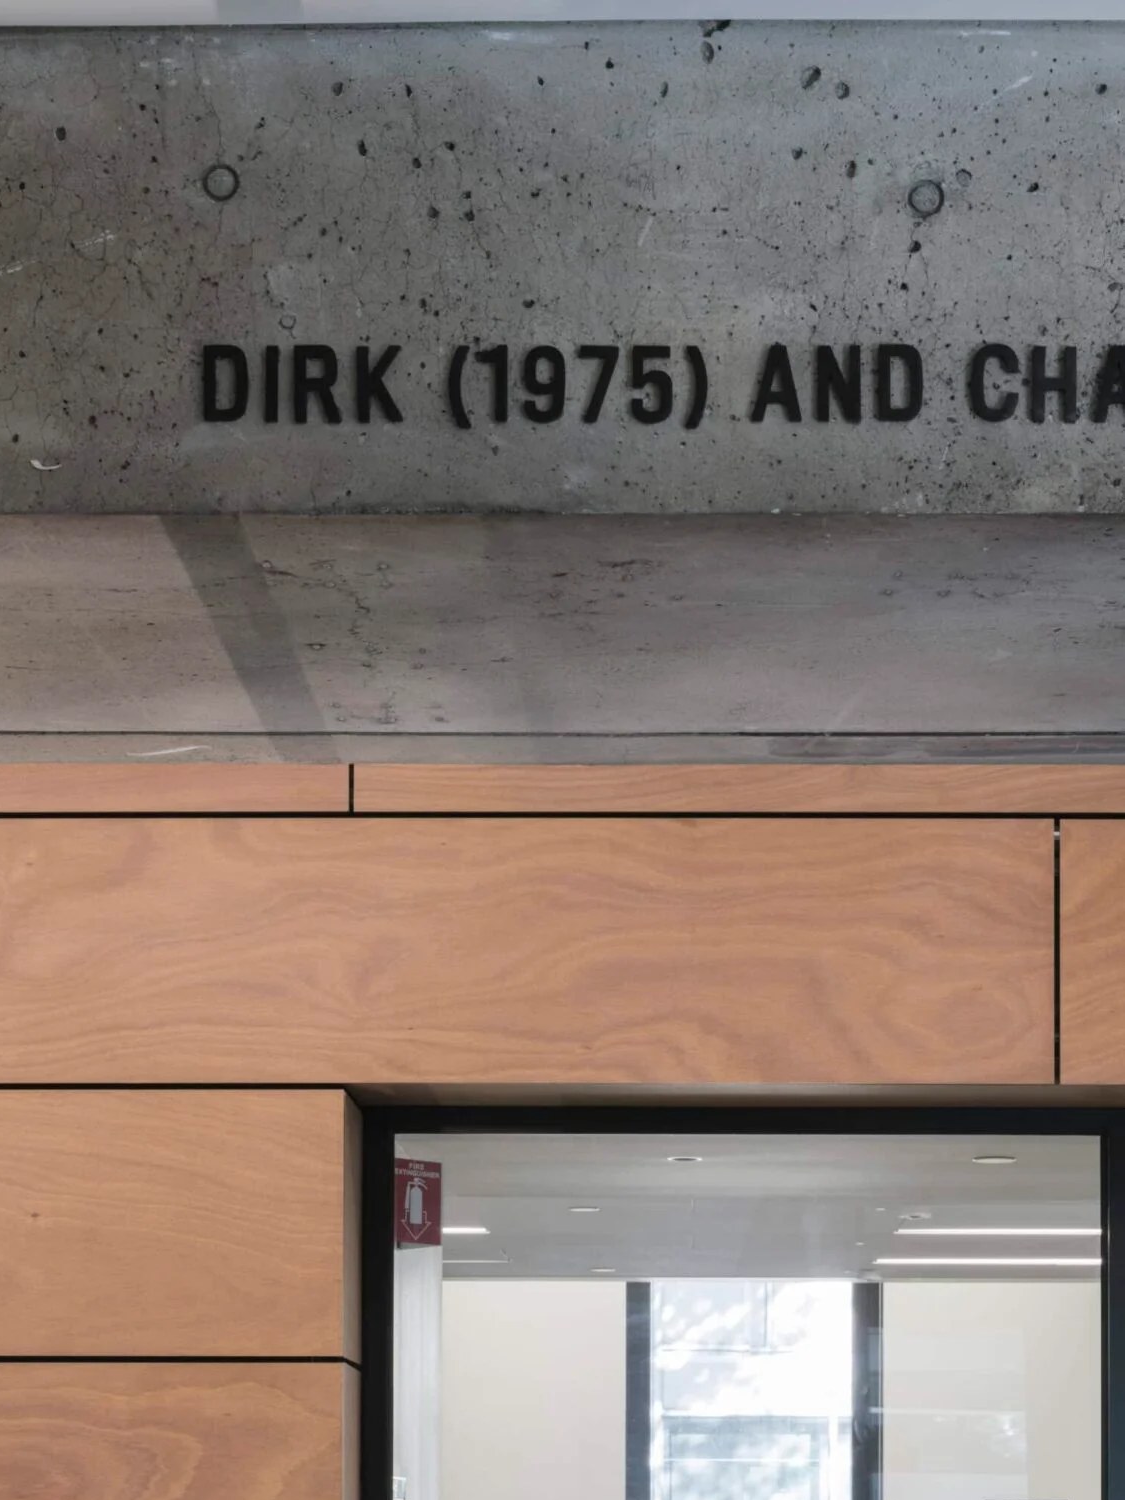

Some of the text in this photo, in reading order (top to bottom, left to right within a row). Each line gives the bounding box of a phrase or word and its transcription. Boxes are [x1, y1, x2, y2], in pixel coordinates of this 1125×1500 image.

[199, 343, 1125, 430] DIRK (1975) AND CHA
